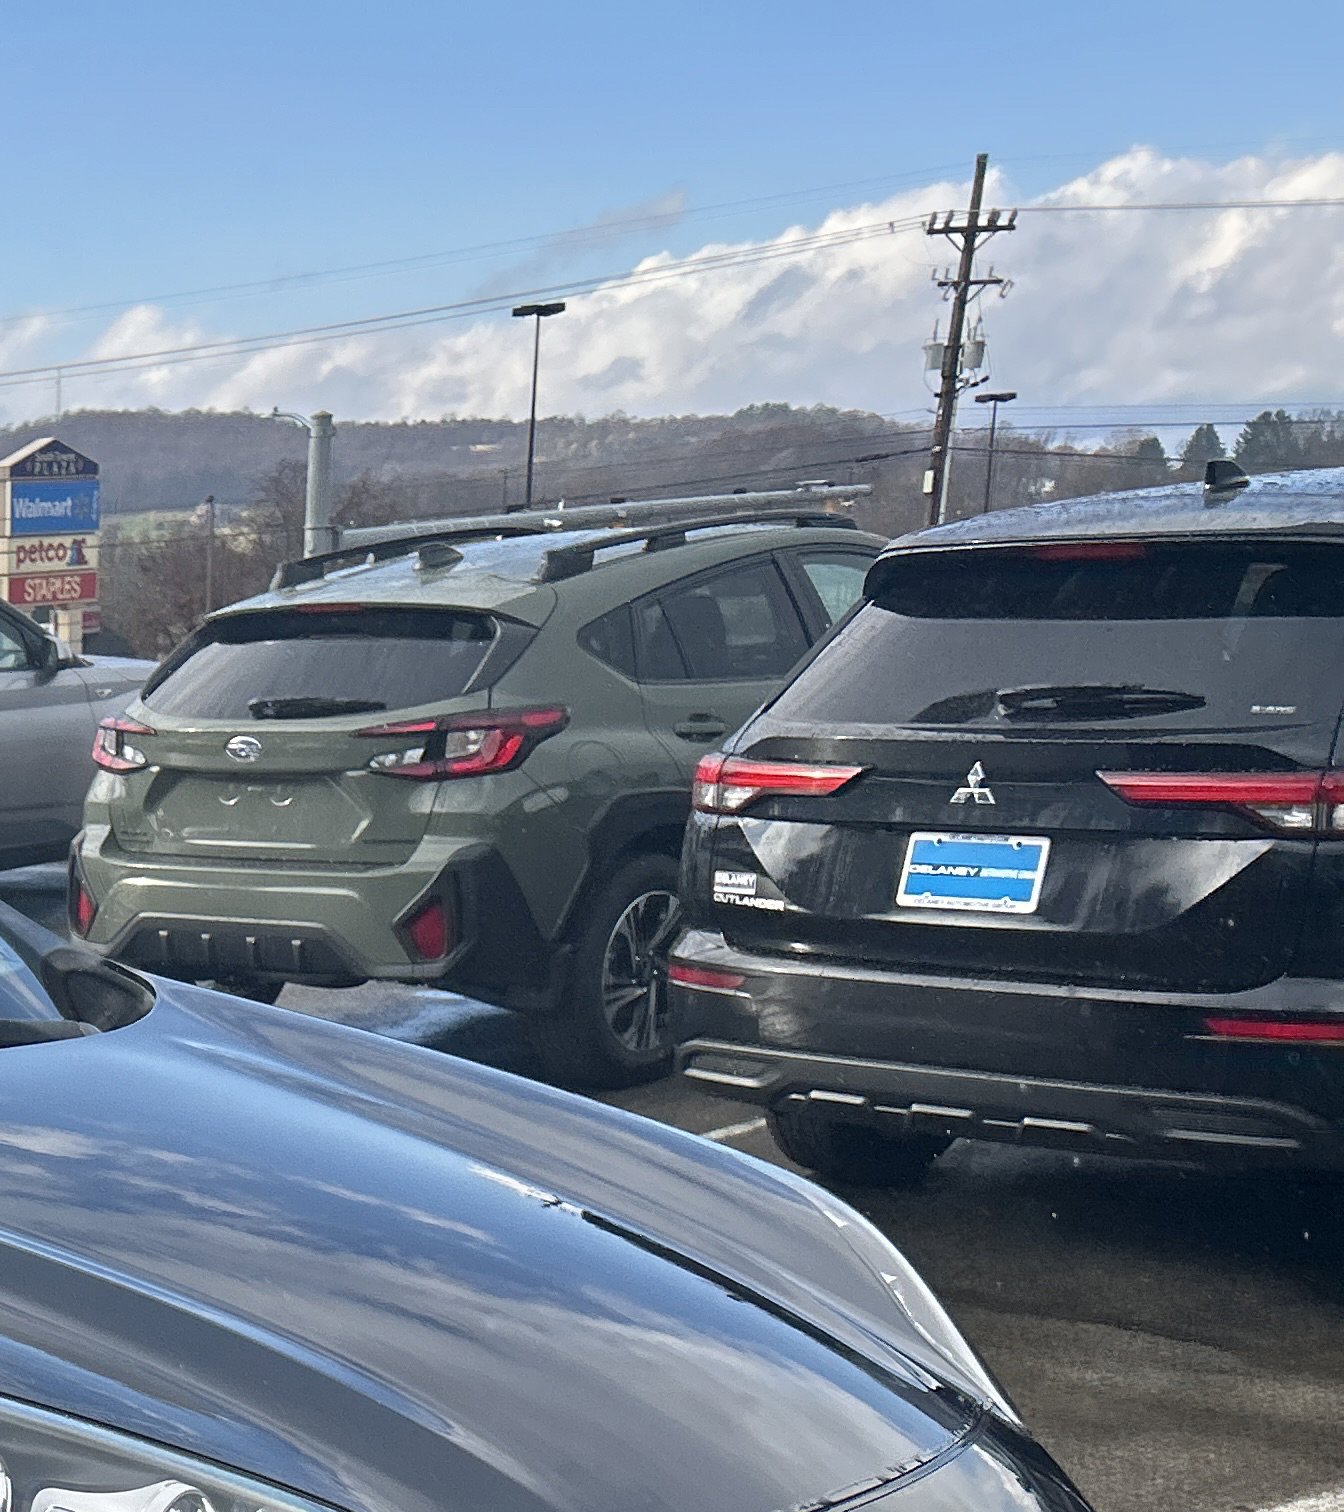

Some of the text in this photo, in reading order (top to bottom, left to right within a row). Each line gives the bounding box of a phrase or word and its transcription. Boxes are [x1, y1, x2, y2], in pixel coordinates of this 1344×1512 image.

[13, 496, 72, 519] Walmart
[16, 540, 68, 570] petco
[24, 576, 81, 601] STAPLES
[713, 892, 785, 911] OUTLANDER
